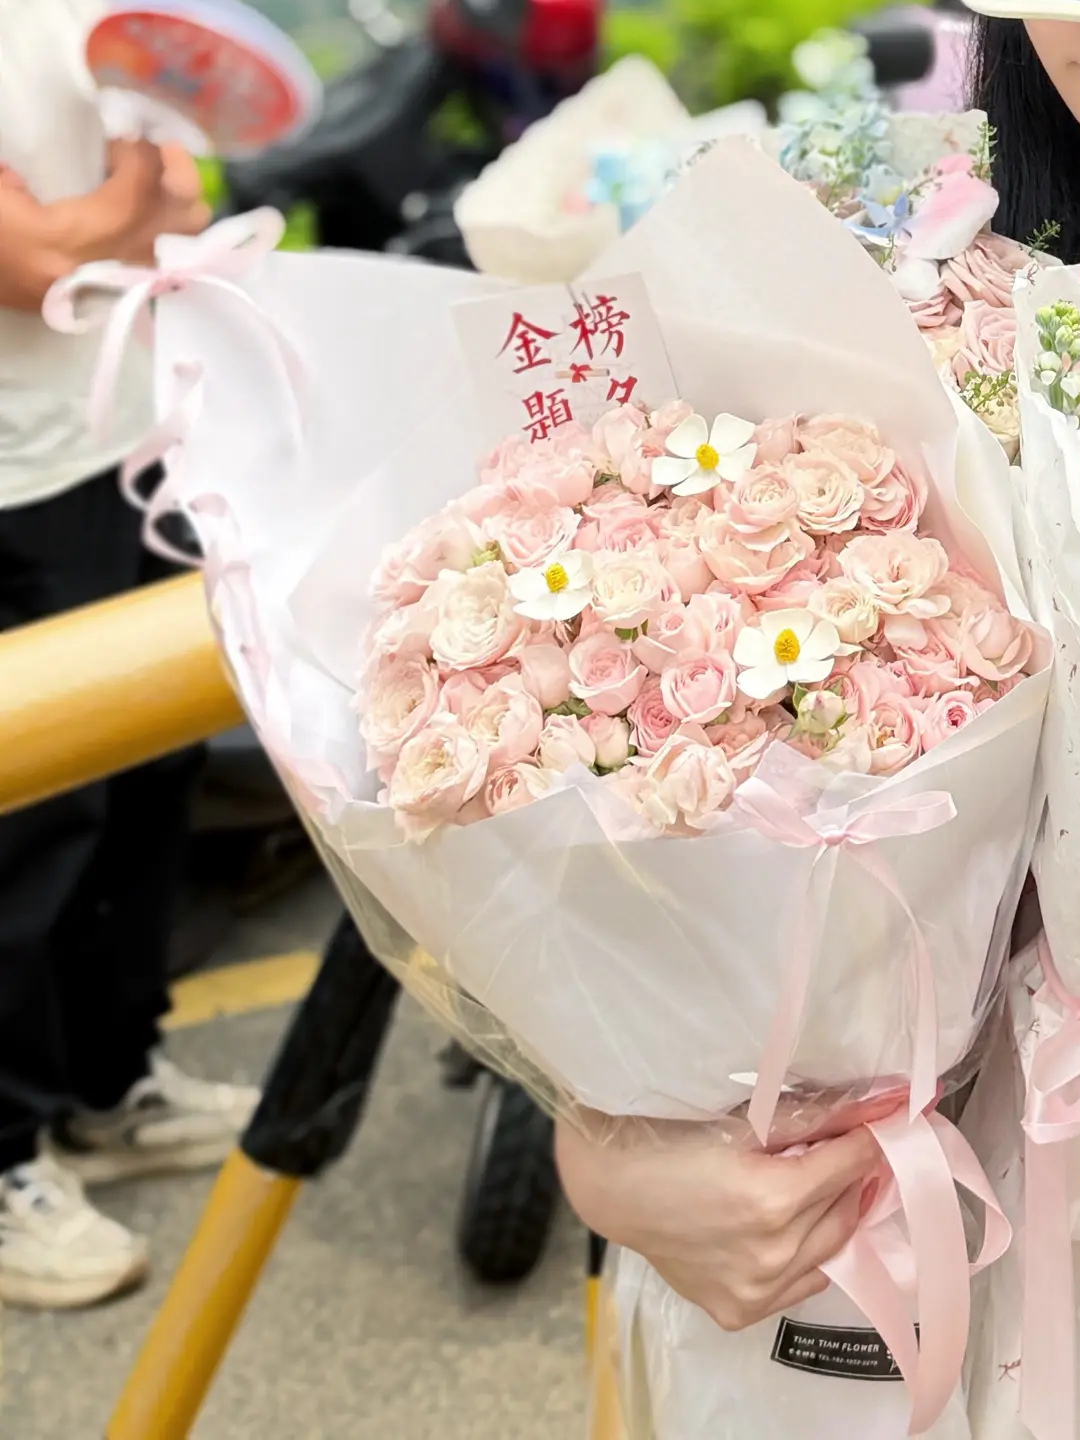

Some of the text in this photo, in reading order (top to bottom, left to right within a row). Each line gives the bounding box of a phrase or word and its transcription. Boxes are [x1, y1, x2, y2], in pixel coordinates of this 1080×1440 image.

[495, 294, 631, 375] 金榜
[793, 1335, 880, 1353] TIAN TIAN FLOWER
